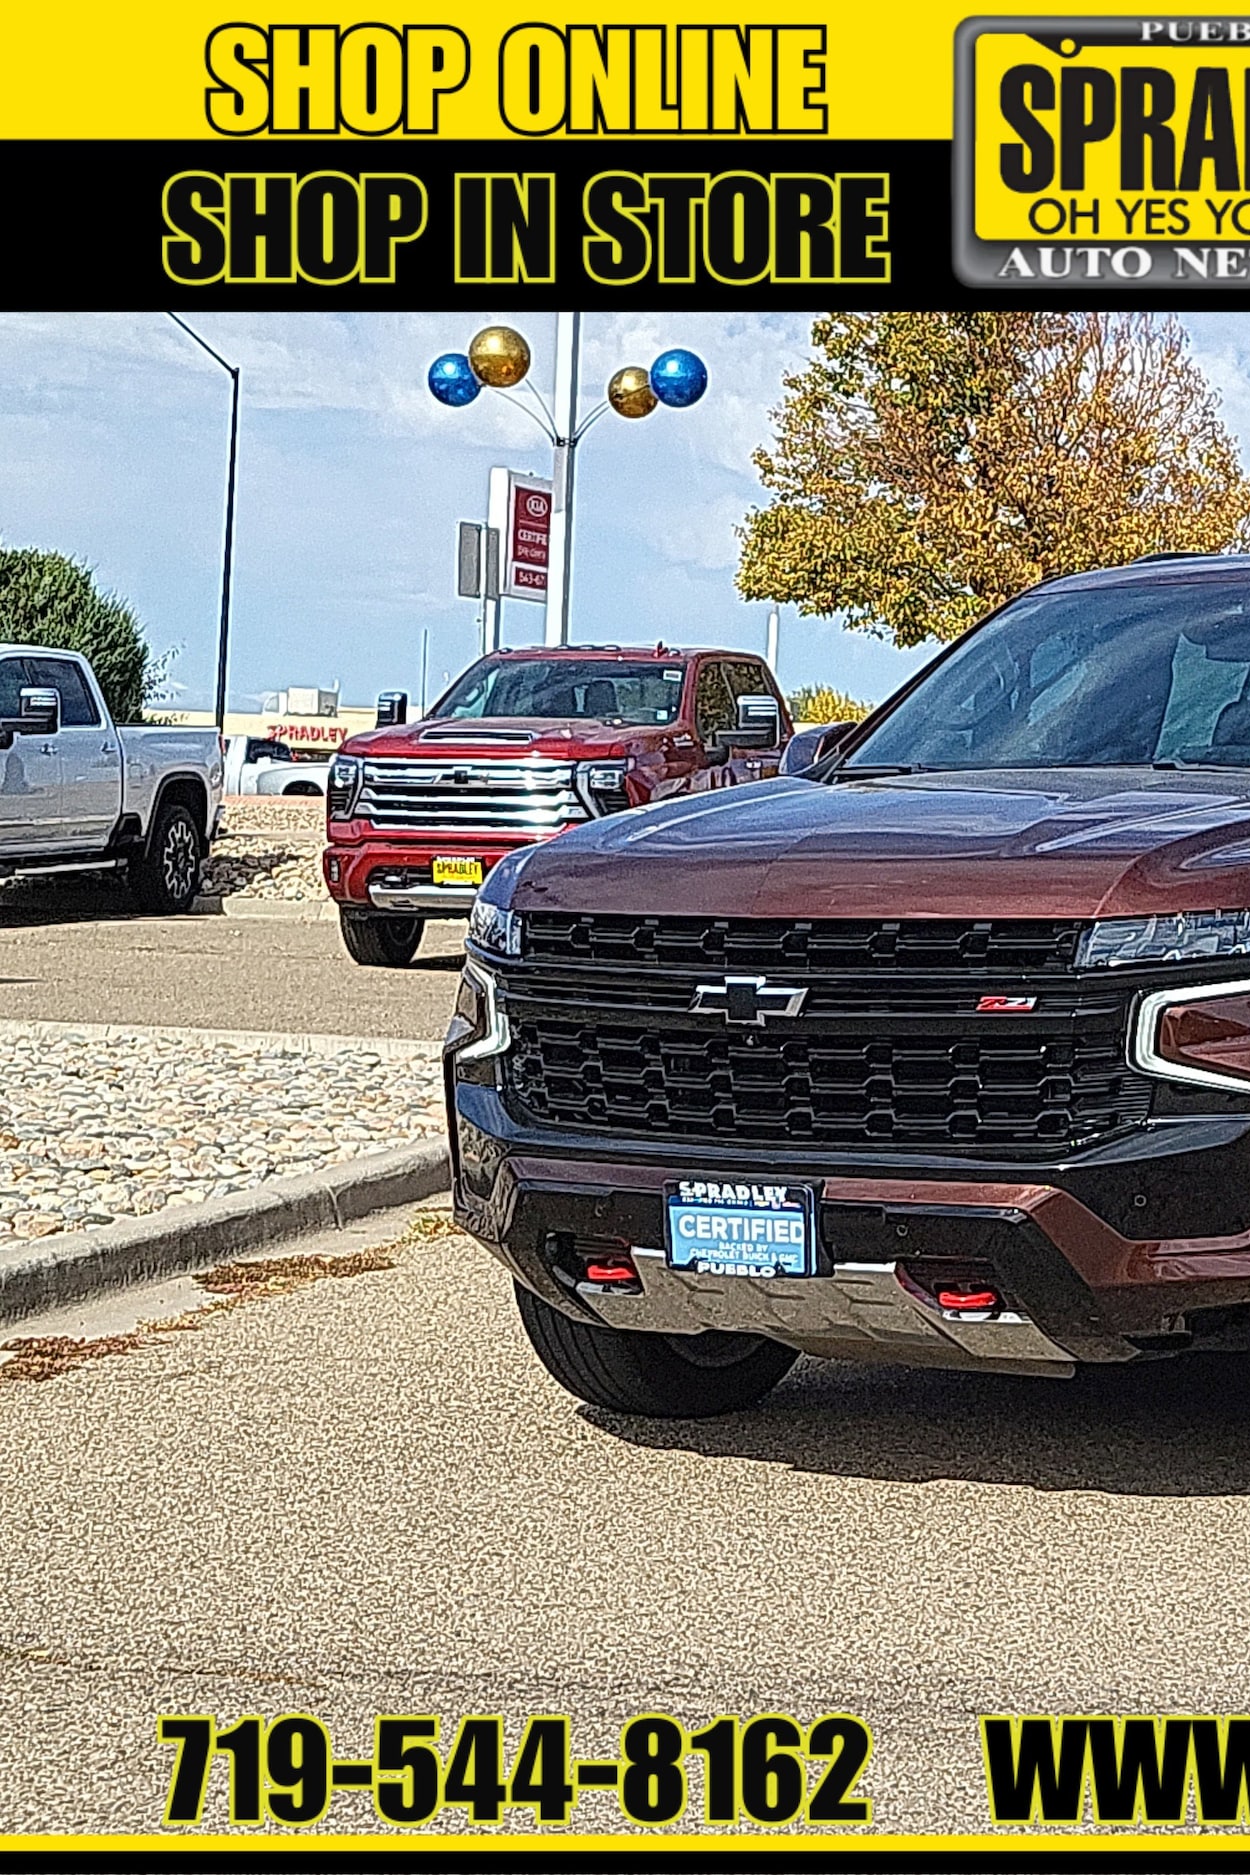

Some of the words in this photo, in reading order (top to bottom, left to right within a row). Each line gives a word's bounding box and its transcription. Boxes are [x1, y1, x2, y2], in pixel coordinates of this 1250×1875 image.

[266, 724, 349, 742] SPRADLEY
[679, 1182, 787, 1202] SPRADLEY
[678, 1215, 805, 1244] CERTIFIED
[690, 1248, 741, 1260] CHEVROLET
[742, 1251, 770, 1262] BUICK
[718, 1242, 754, 1253] BACKED
[756, 1244, 769, 1252] BY
[697, 1262, 776, 1278] PUEBLO
